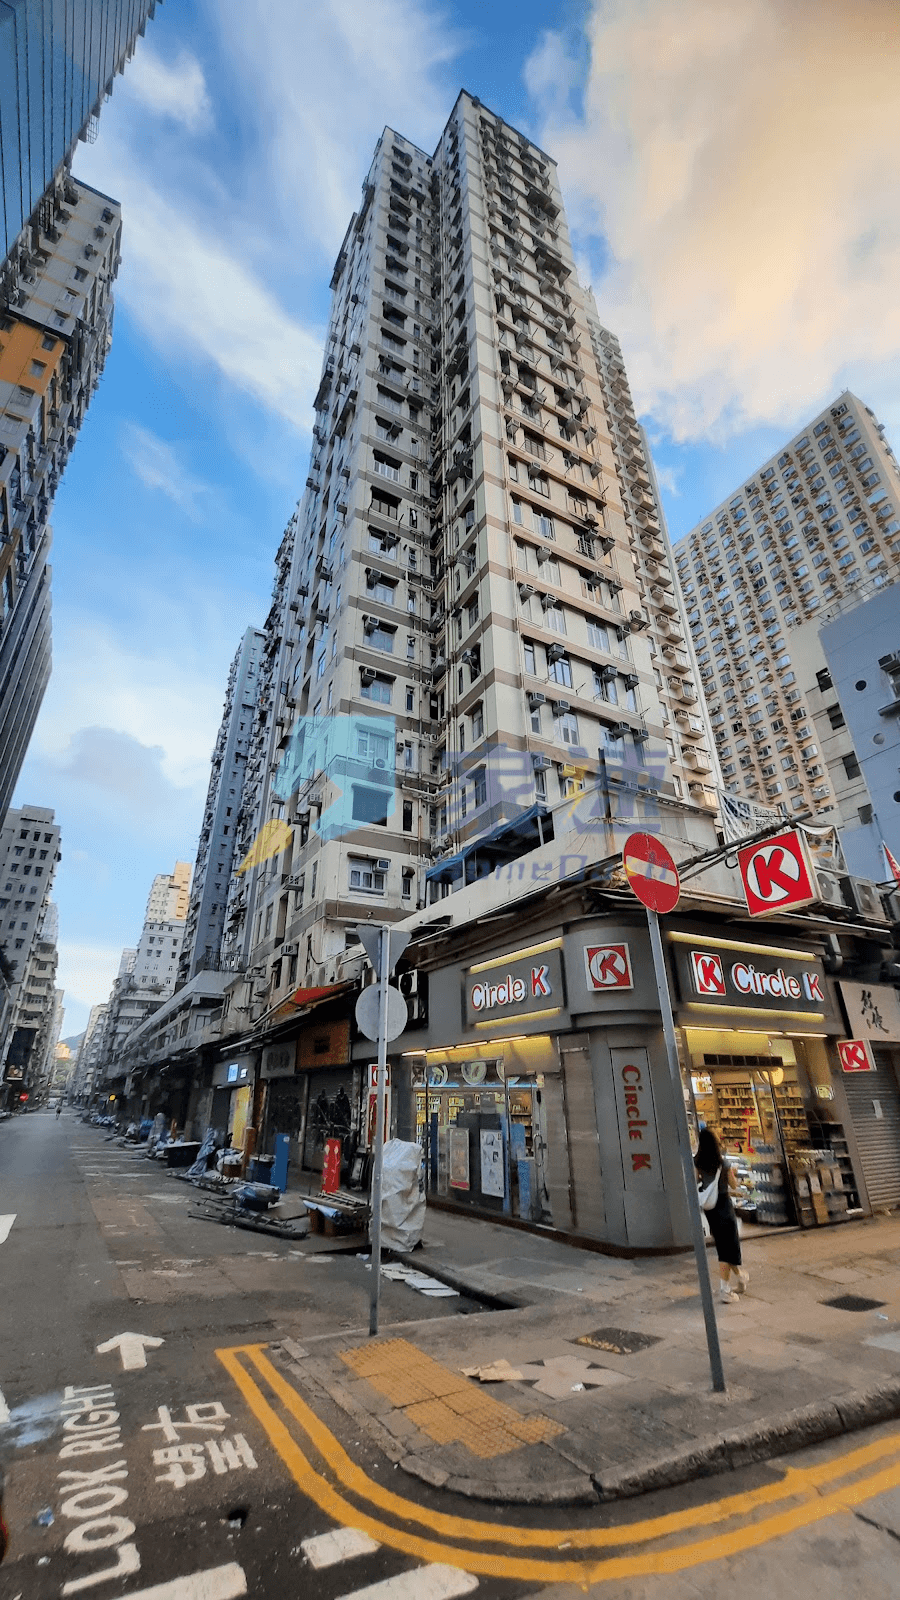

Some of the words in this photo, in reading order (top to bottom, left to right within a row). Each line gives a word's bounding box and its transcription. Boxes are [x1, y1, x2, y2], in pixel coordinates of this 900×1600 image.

[753, 848, 800, 899] K
[471, 974, 527, 1012] Circle
[531, 964, 551, 997] K
[595, 952, 624, 983] K
[700, 958, 722, 991] K
[731, 962, 801, 999] Circle
[802, 971, 824, 1001] K
[844, 1045, 865, 1067] K
[631, 1153, 651, 1172] K
[58, 1384, 124, 1459] RIGHT
[141, 1401, 259, 1489] 望右
[57, 1460, 141, 1595] LOOK
